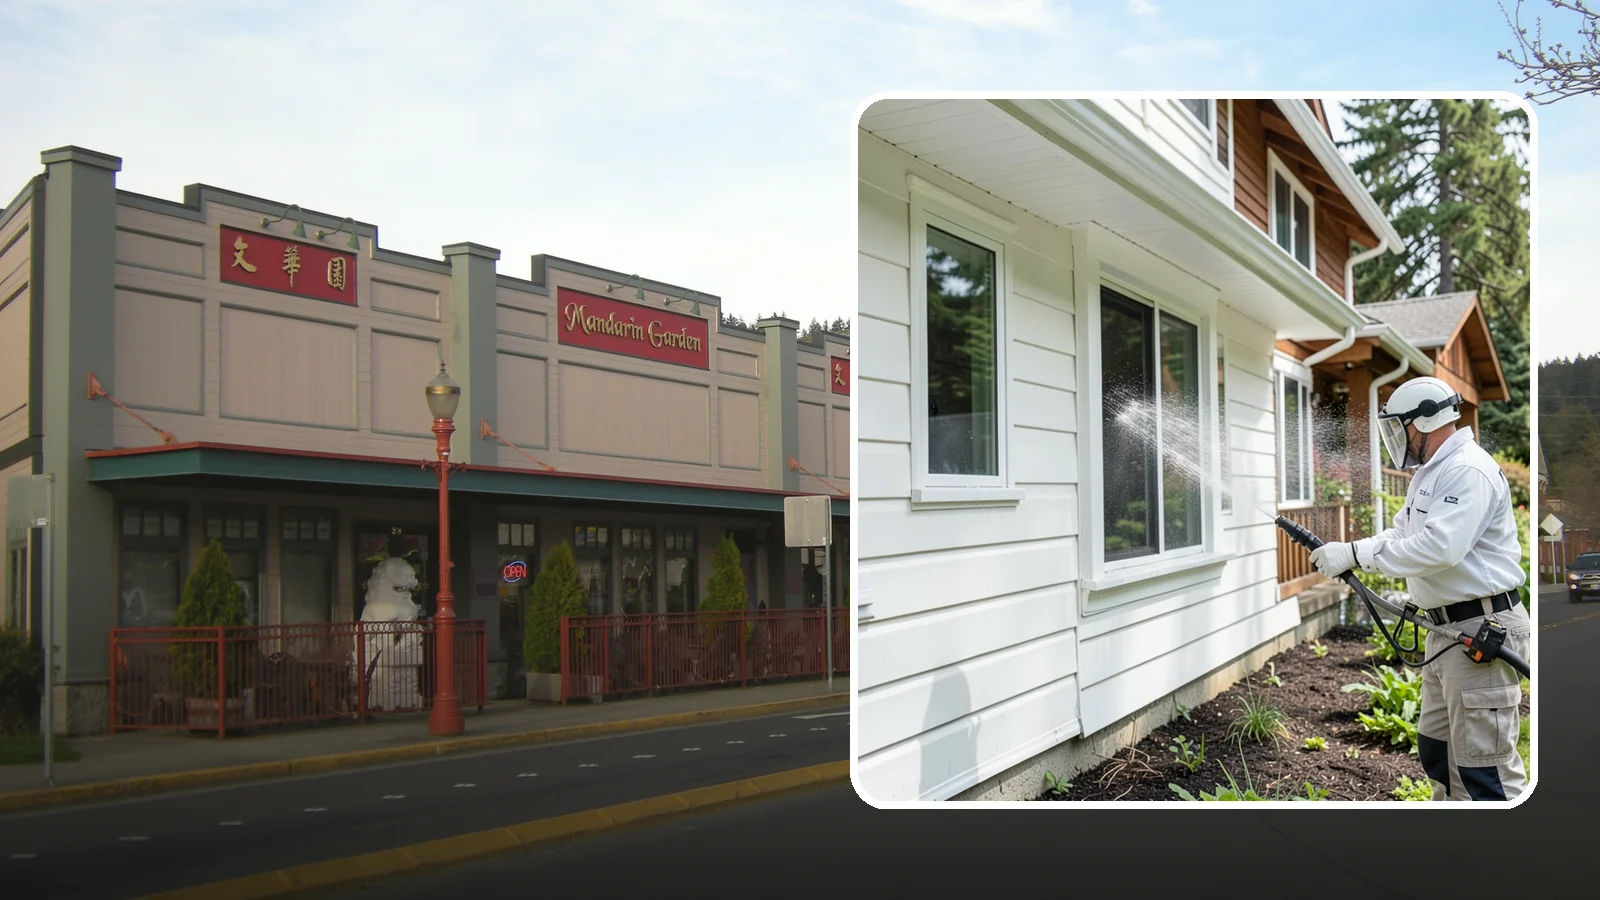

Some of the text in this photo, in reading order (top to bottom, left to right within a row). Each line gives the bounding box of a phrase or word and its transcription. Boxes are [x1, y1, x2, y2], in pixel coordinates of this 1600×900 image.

[565, 302, 701, 352] Mandarin Garden
[503, 565, 527, 578] OPEN
